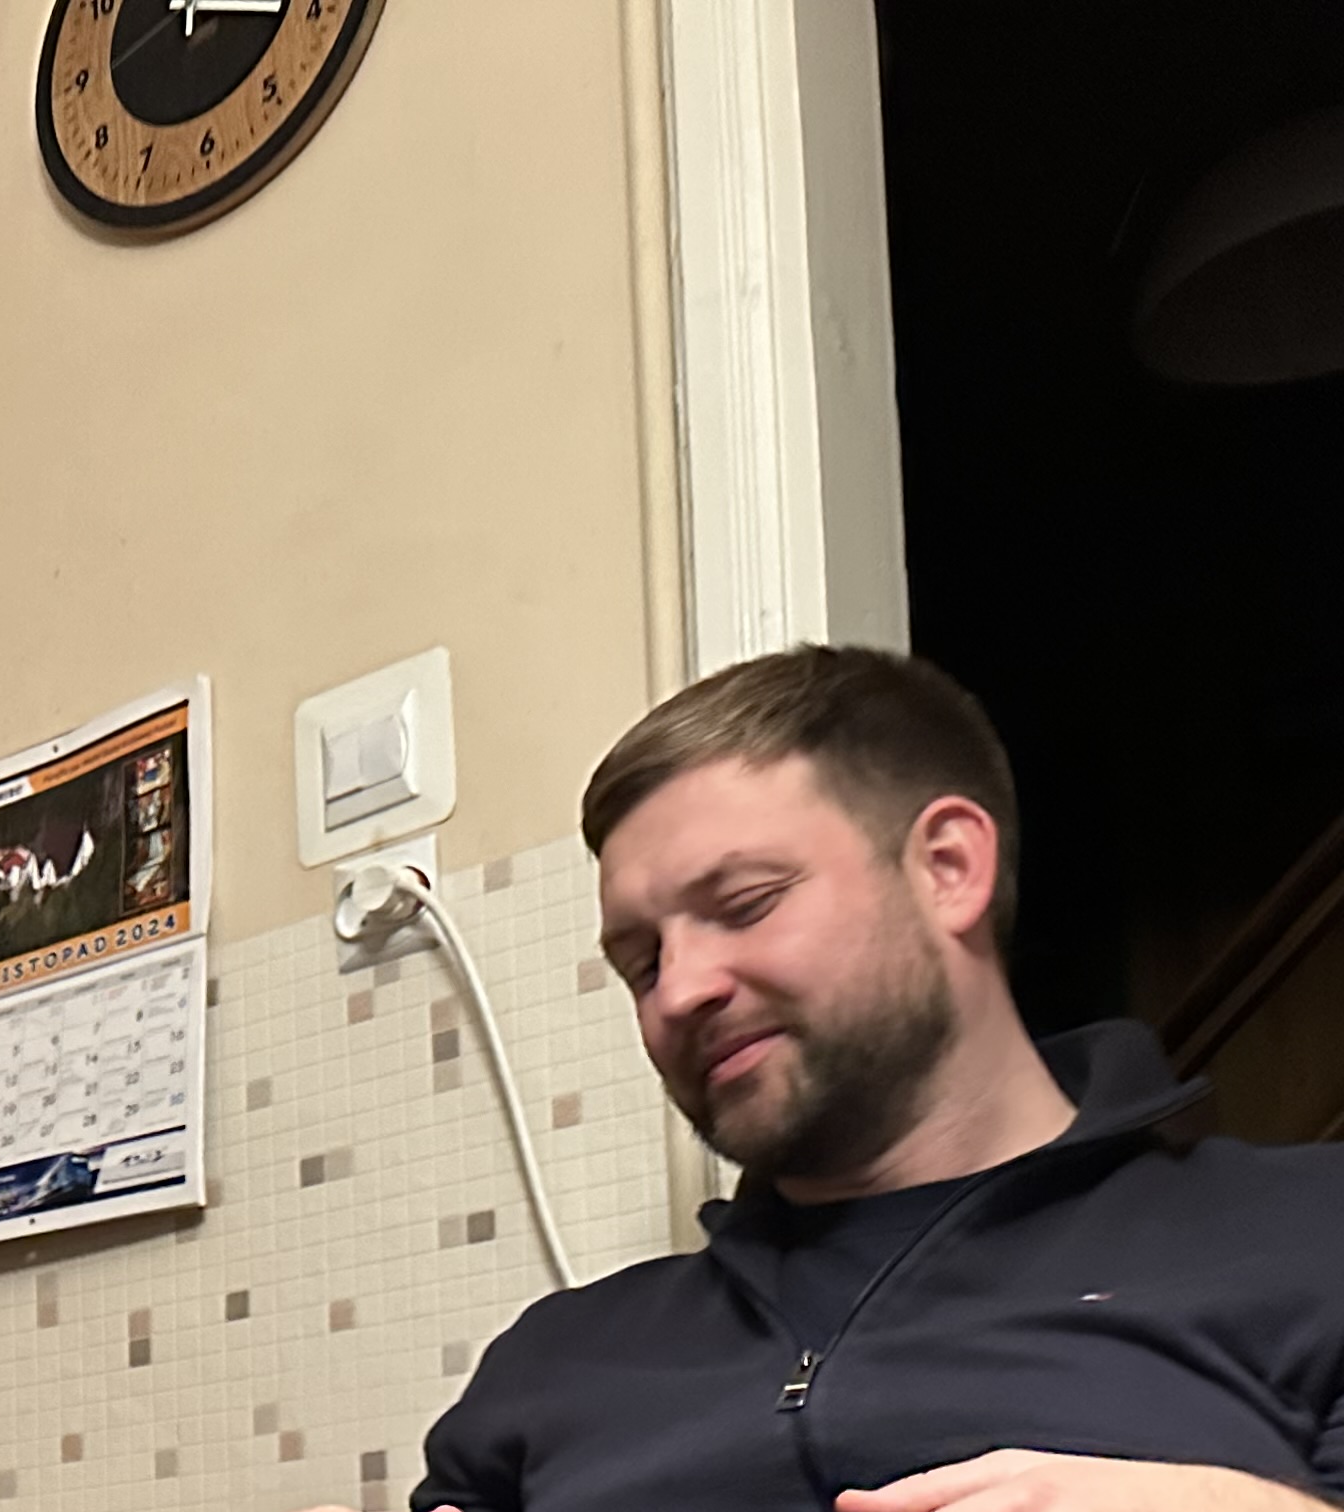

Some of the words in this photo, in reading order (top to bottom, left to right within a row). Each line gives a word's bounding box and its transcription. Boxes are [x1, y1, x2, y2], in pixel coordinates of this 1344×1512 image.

[92, 0, 113, 21] 10
[306, 0, 322, 20] 4
[76, 69, 89, 94] 9
[262, 70, 277, 102] 5
[95, 124, 108, 149] 8
[200, 127, 215, 156] 6
[139, 143, 154, 173] 7
[115, 914, 177, 947] 2024
